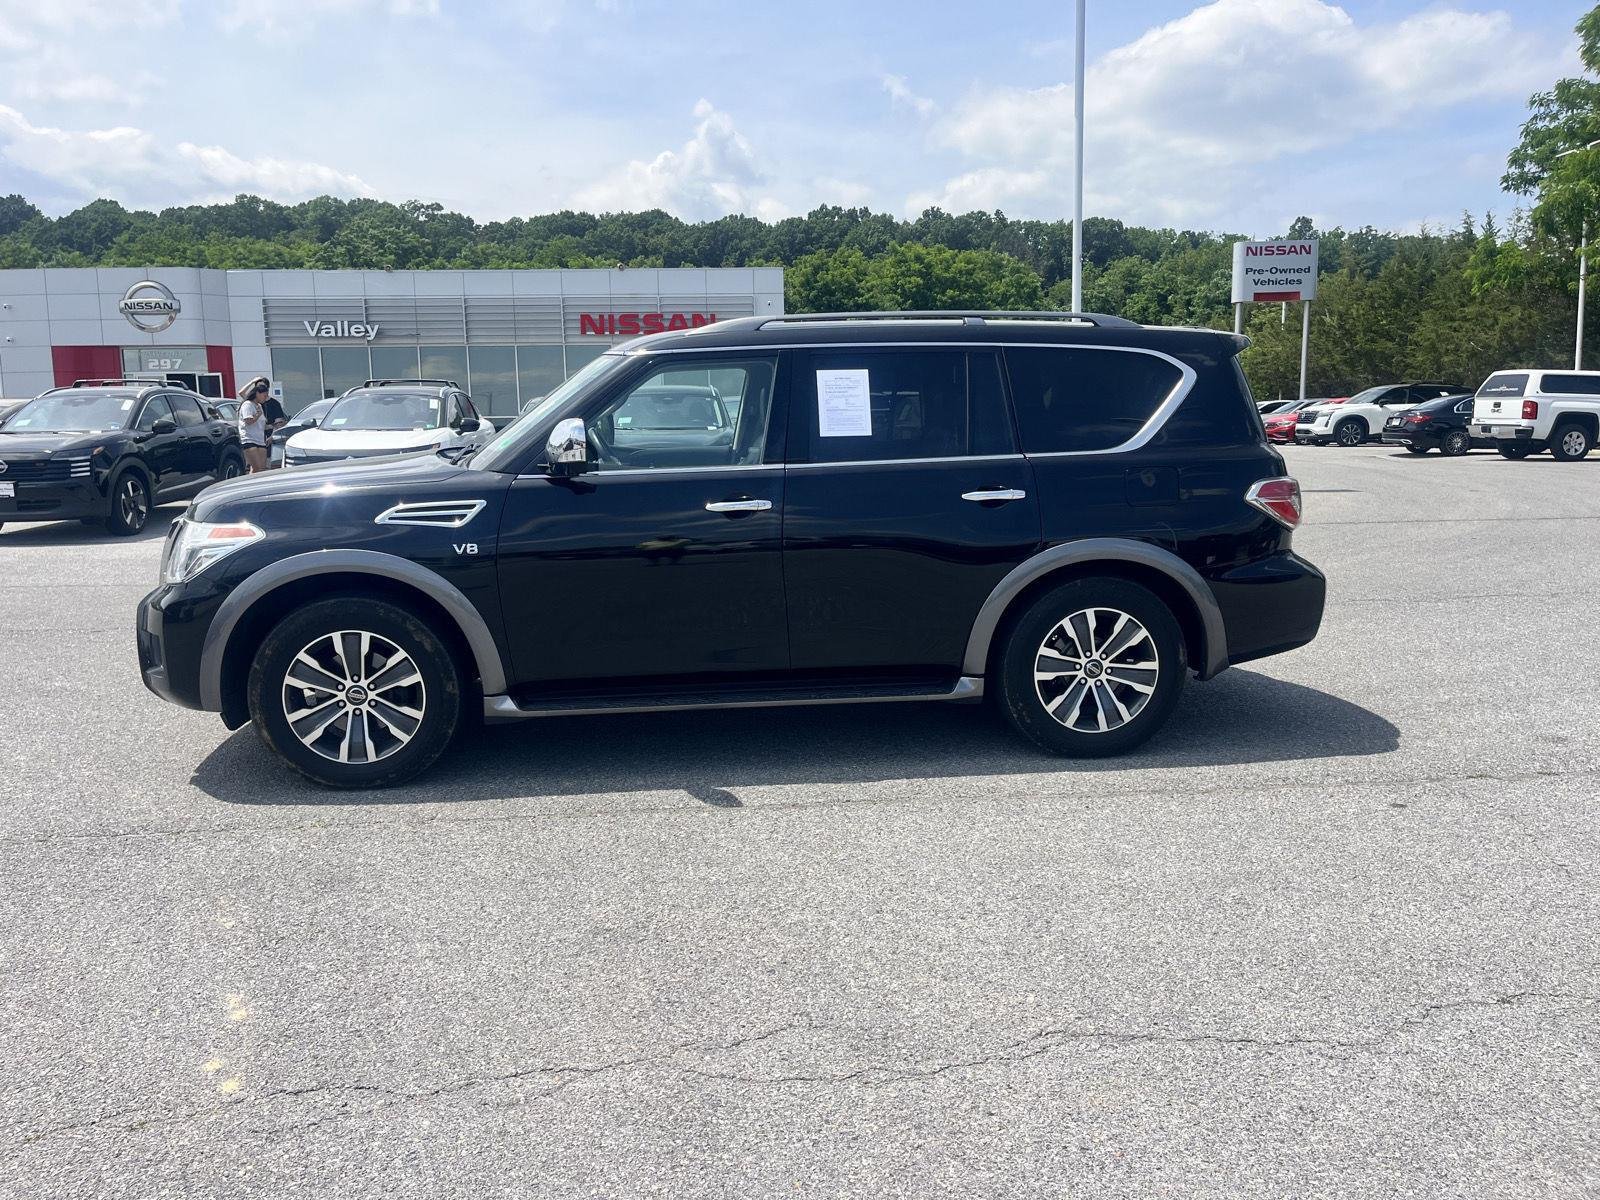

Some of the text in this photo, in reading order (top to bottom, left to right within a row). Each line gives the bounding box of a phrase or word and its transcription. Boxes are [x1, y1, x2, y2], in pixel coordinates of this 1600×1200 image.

[1246, 244, 1312, 257] NISSAN
[1245, 266, 1311, 275] Pre-Owned
[1252, 278, 1303, 286] Vehicles
[124, 302, 174, 310] NISSAN
[303, 320, 380, 341] Valley
[148, 358, 183, 370] 297
[452, 543, 479, 555] V8
